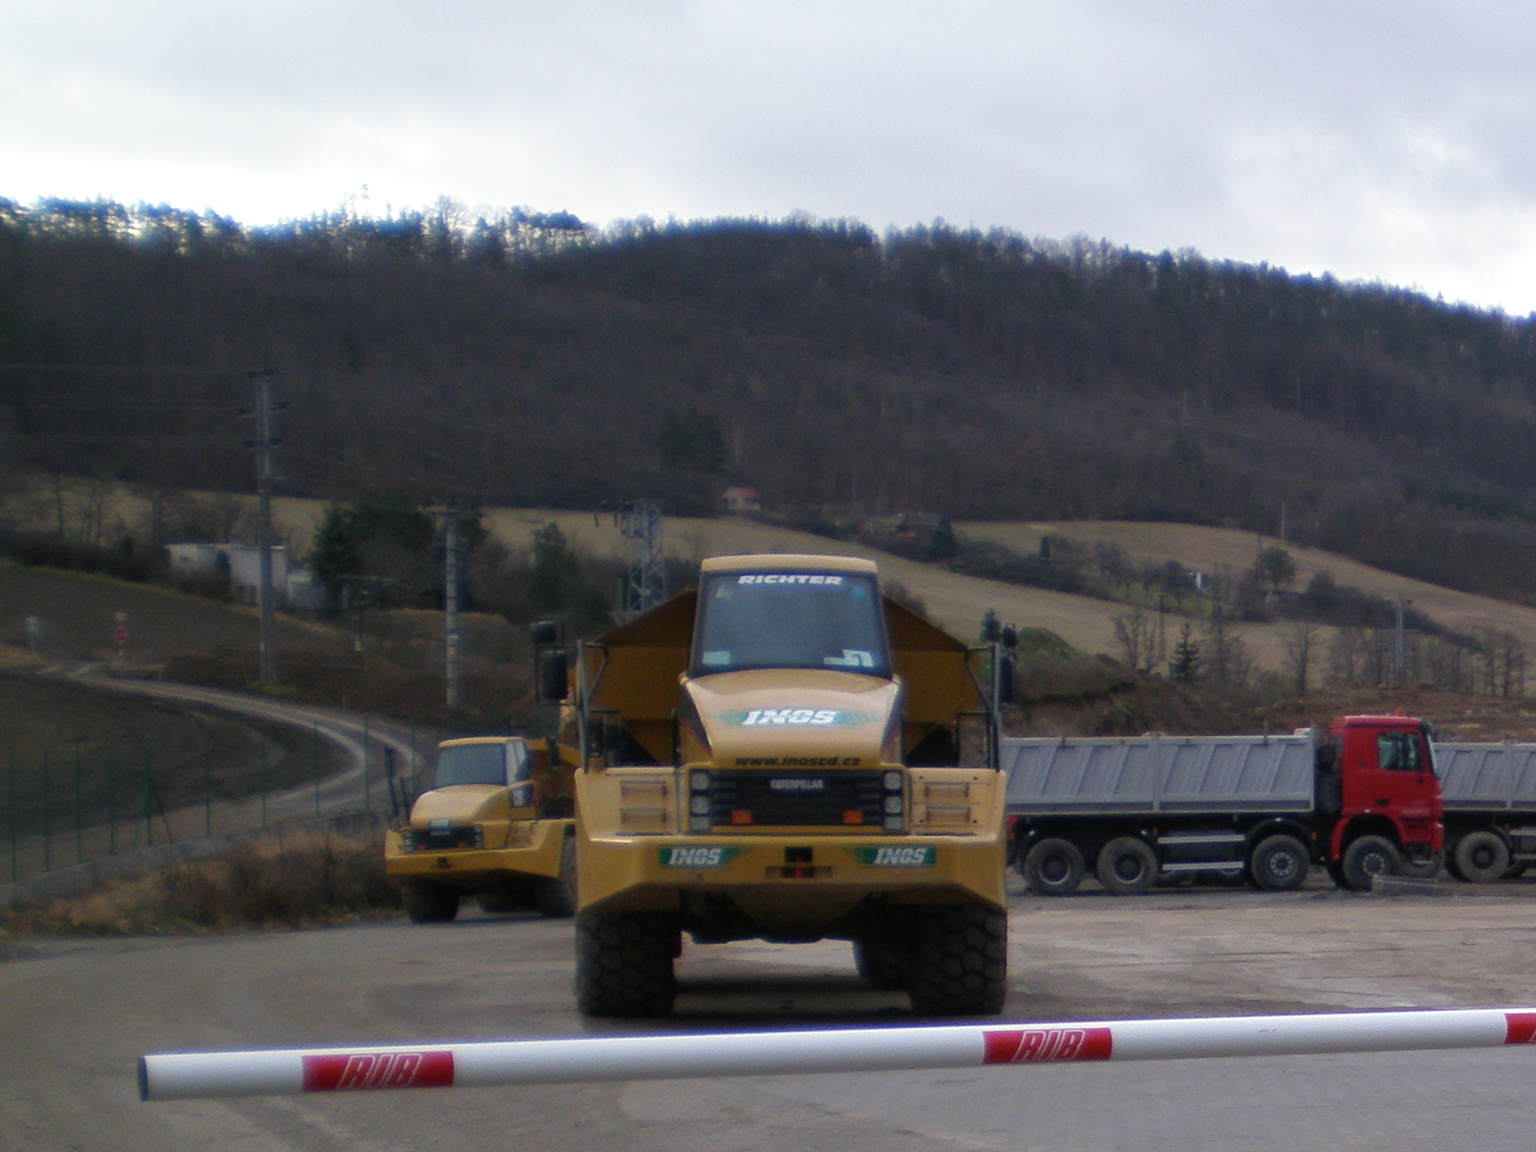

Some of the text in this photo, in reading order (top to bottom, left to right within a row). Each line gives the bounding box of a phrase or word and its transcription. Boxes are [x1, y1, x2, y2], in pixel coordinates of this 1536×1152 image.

[737, 574, 843, 586] RICHTER
[742, 708, 837, 726] INOS
[735, 755, 861, 767] www.inoscd.cz
[770, 778, 824, 790] CATERPILLAR
[668, 847, 722, 866] INOS
[873, 847, 926, 865] INOS
